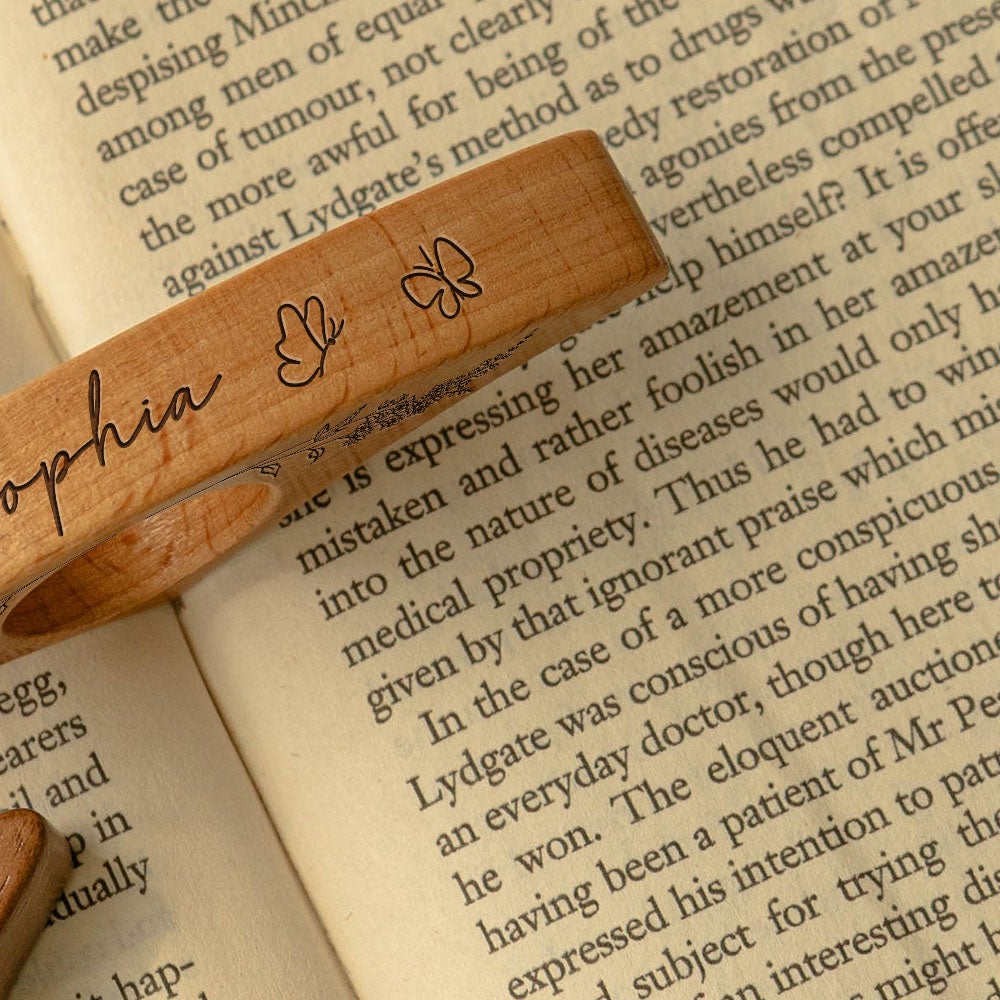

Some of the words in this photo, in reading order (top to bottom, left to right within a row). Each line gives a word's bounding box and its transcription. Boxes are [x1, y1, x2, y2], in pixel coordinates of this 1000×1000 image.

[50, 16, 142, 73] make
[95, 94, 214, 163] among
[219, 57, 298, 106] men
[306, 20, 344, 65] of
[639, 113, 766, 190] agonies
[767, 73, 857, 127] from
[857, 43, 917, 84] the
[668, 19, 854, 119] restoration
[138, 212, 196, 252] the
[204, 166, 296, 223] more
[306, 108, 400, 176] awful
[406, 89, 459, 129] for
[464, 40, 568, 101] being
[576, 4, 614, 50] of
[704, 179, 846, 269] himself?
[852, 164, 894, 199] It
[893, 147, 929, 181] is
[314, 572, 388, 621] into
[396, 538, 455, 580] the
[463, 484, 576, 550] nature
[585, 448, 624, 493] of
[633, 397, 764, 473] diseases
[770, 332, 881, 406] would
[888, 300, 961, 353] only
[416, 708, 468, 746] In
[471, 677, 531, 719] the
[538, 641, 611, 688] case
[619, 604, 659, 650] of
[664, 606, 689, 631] a
[692, 561, 788, 619] more
[795, 460, 1000, 571] conspicuous
[450, 868, 503, 907] he
[512, 825, 602, 874] won.
[608, 777, 692, 825] The
[706, 699, 859, 784] eloquent
[506, 894, 670, 1000] expressed
[666, 875, 727, 920] his
[726, 805, 893, 893] intention
[893, 785, 934, 817] to
[765, 892, 958, 996] interesting
